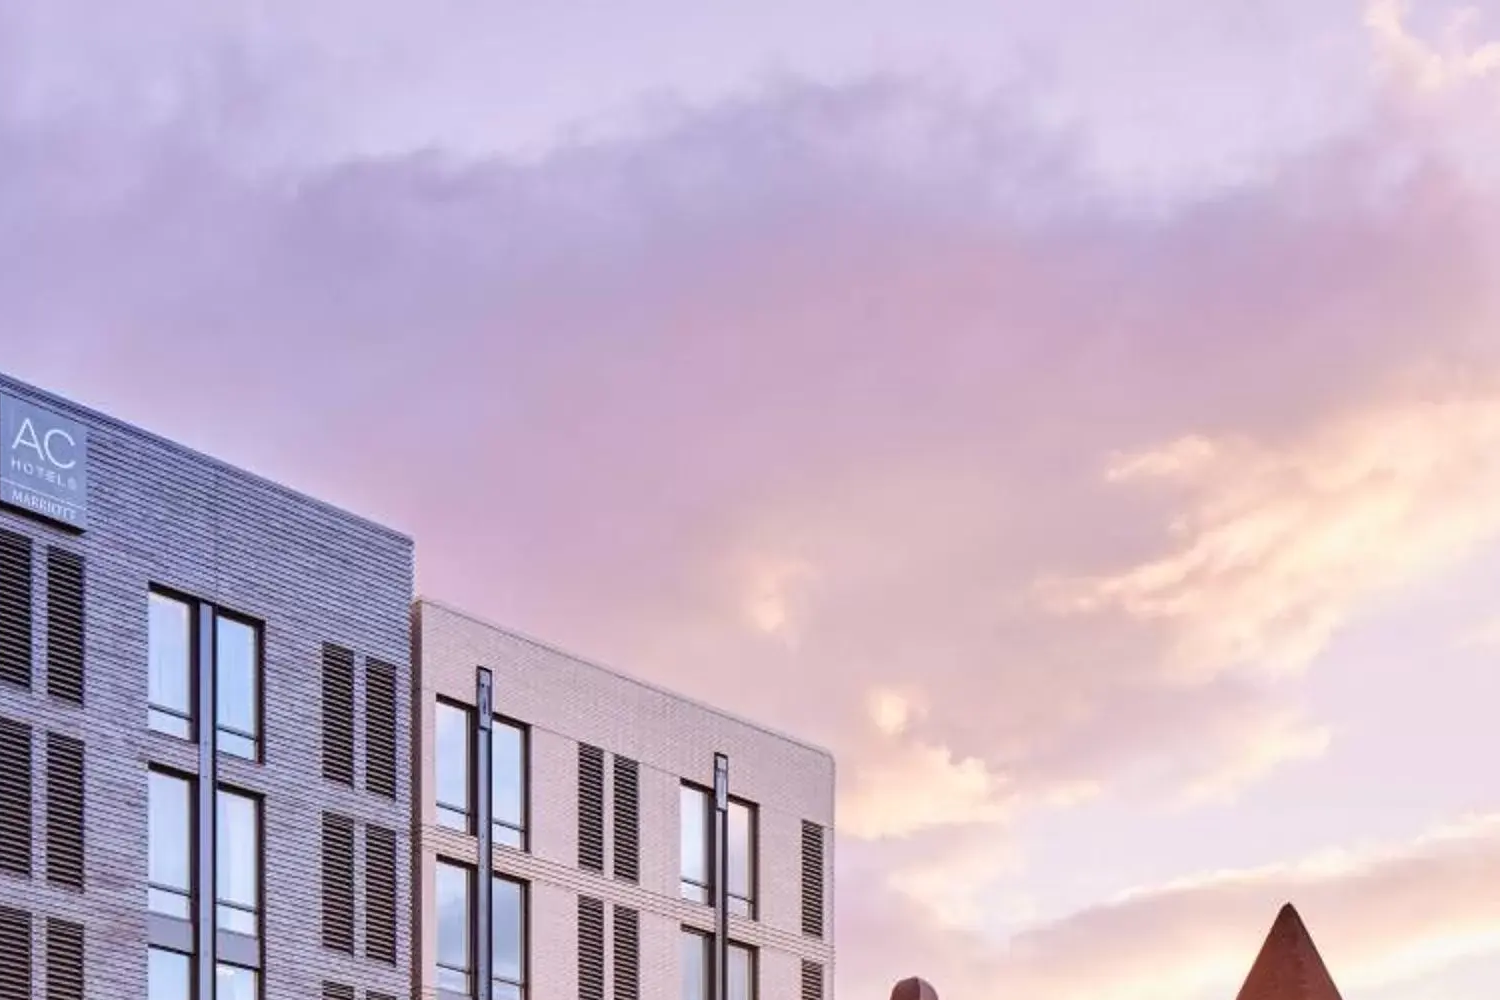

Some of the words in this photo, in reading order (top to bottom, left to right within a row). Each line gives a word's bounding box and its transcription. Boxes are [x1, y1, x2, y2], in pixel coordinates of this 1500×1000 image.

[11, 417, 76, 469] AC
[11, 457, 77, 491] HOTELS
[11, 489, 77, 521] MARRIOTT
